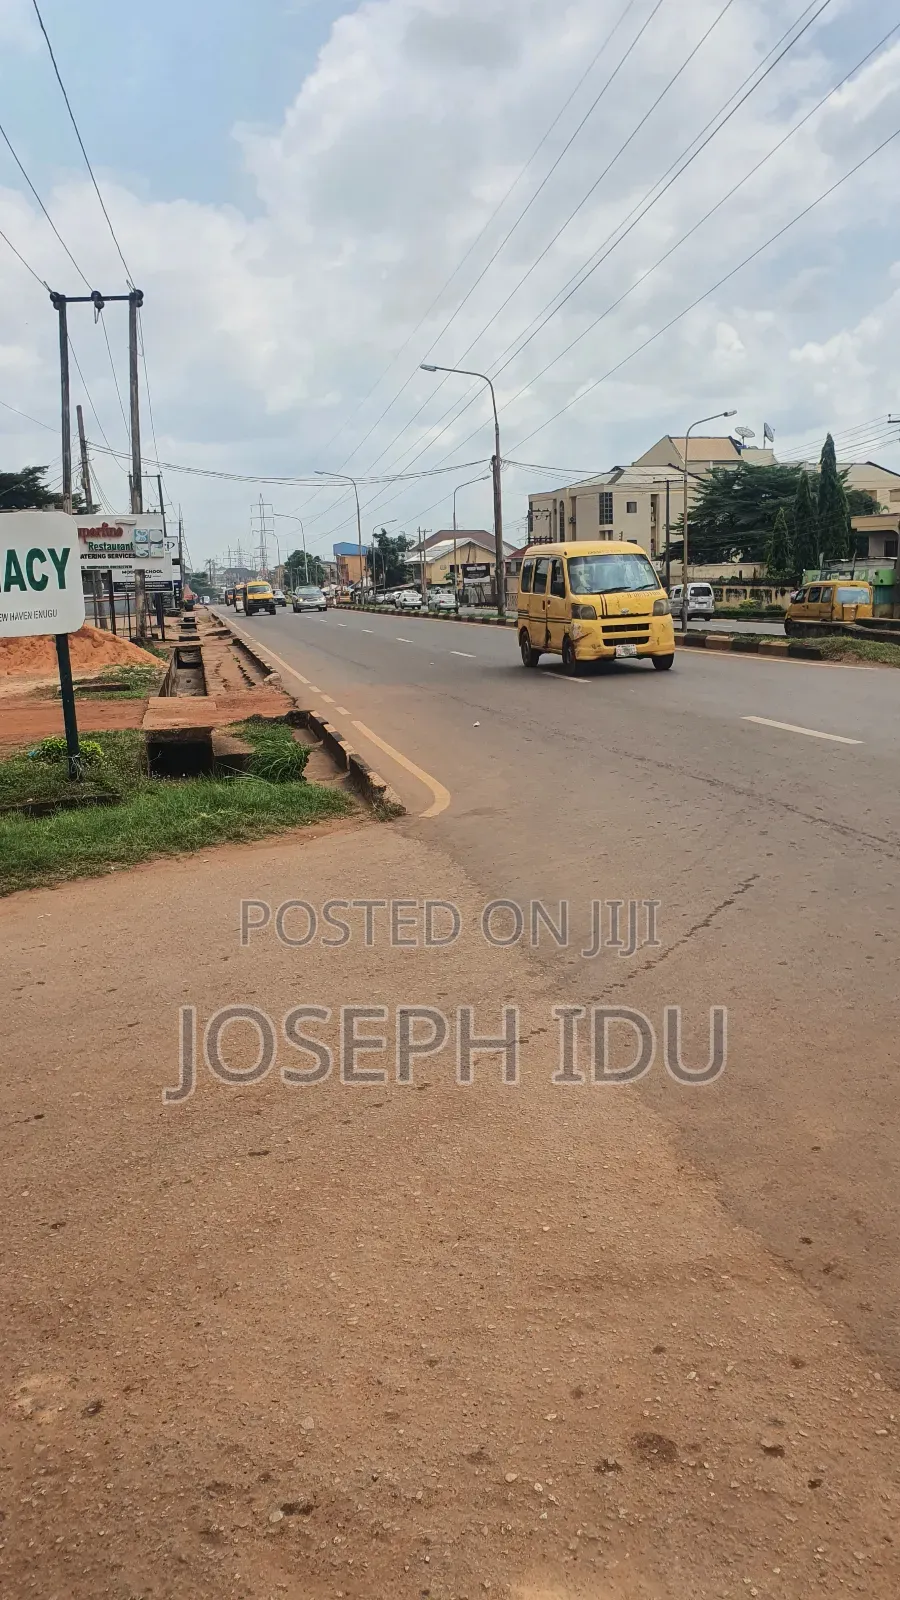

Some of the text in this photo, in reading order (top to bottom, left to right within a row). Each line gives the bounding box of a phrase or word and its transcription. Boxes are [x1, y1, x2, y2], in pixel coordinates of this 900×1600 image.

[88, 541, 134, 551] Restaurant
[0, 547, 71, 593] ACY
[9, 611, 32, 621] HAVEN
[33, 609, 58, 619] ENUGU
